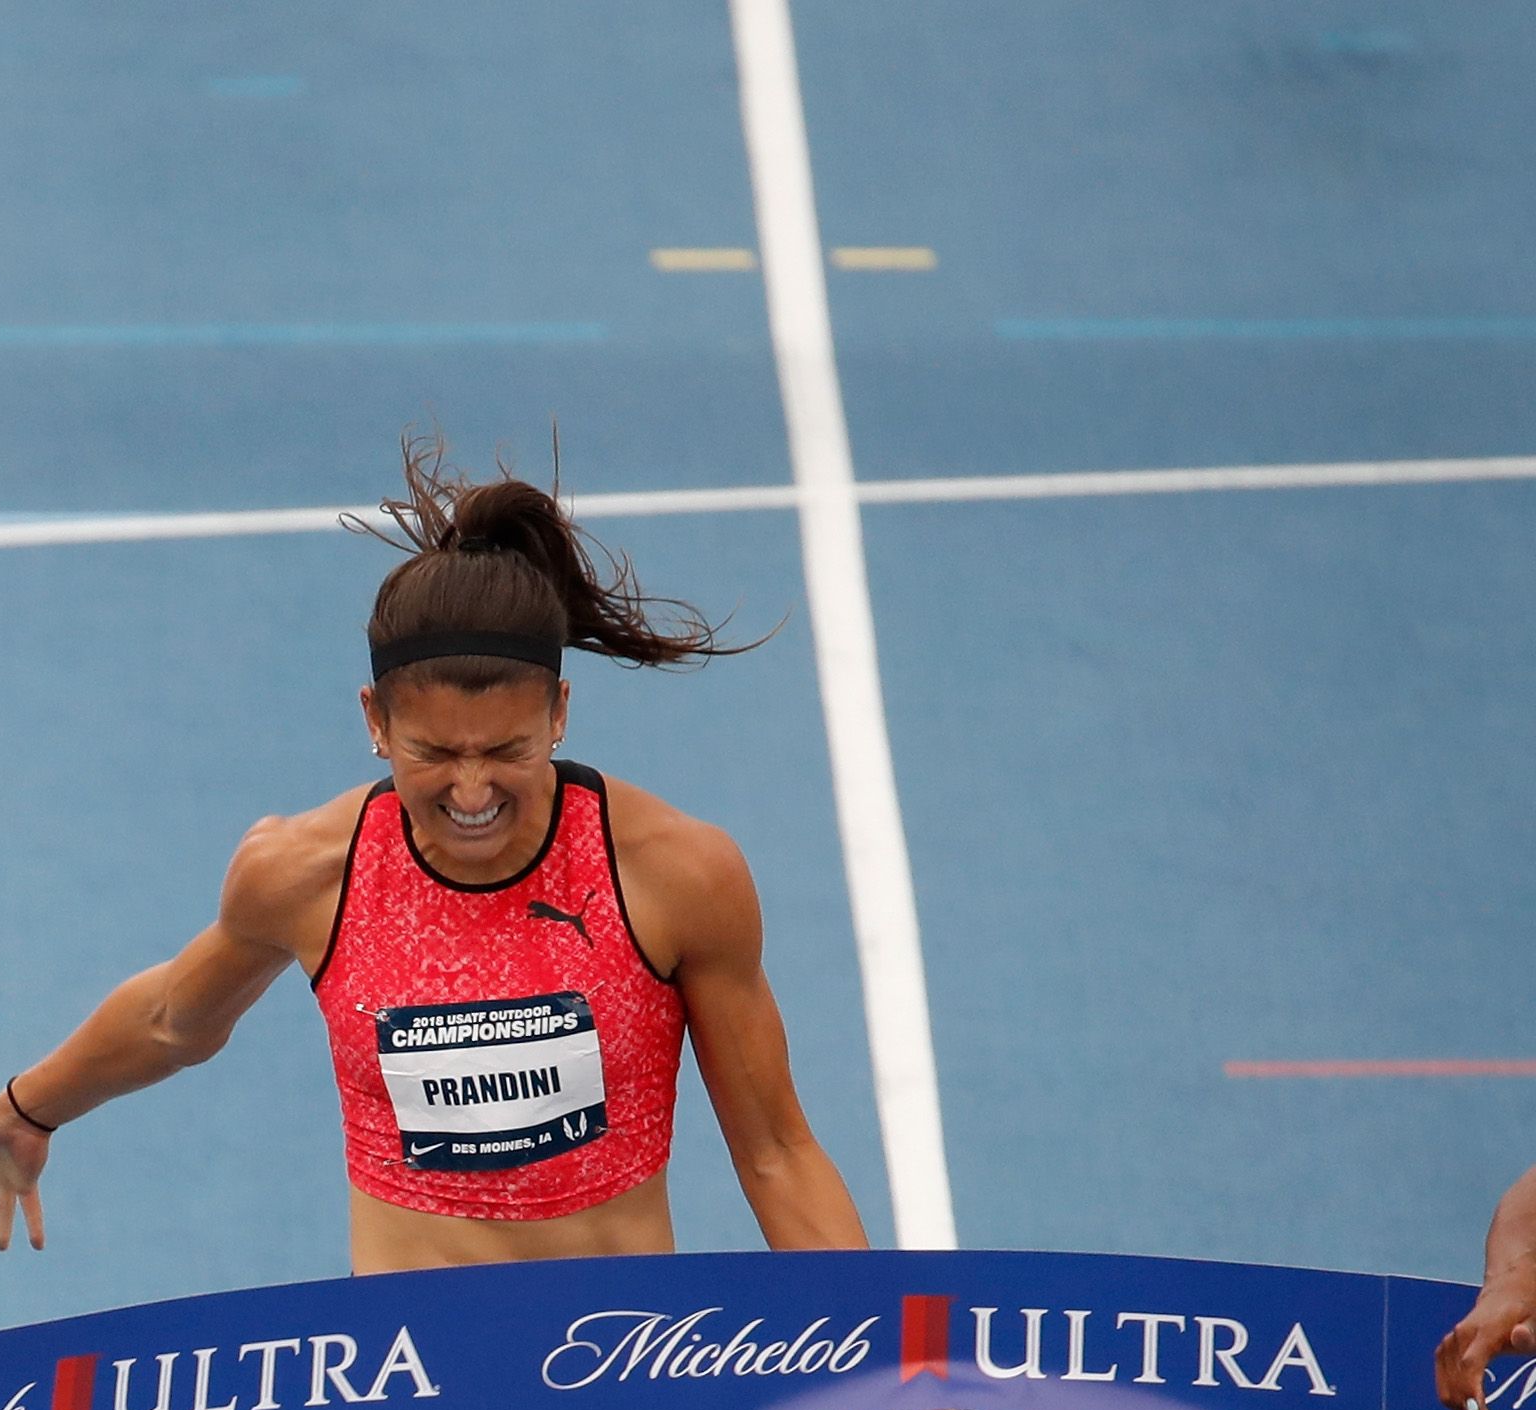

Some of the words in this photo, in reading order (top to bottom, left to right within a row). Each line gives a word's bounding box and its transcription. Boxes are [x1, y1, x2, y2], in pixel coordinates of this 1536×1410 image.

[391, 1012, 578, 1048] CHAMPIONSHIPS
[413, 1016, 444, 1028] 2018
[447, 1012, 487, 1026] USATF
[489, 1005, 551, 1022] OUTDOOR
[422, 1065, 562, 1106] PRANDINI
[452, 1143, 477, 1154] DES
[479, 1138, 536, 1154] MOINES,
[538, 1131, 553, 1143] IA
[541, 1306, 883, 1391] Michelob
[969, 1306, 1336, 1397] ULTRA
